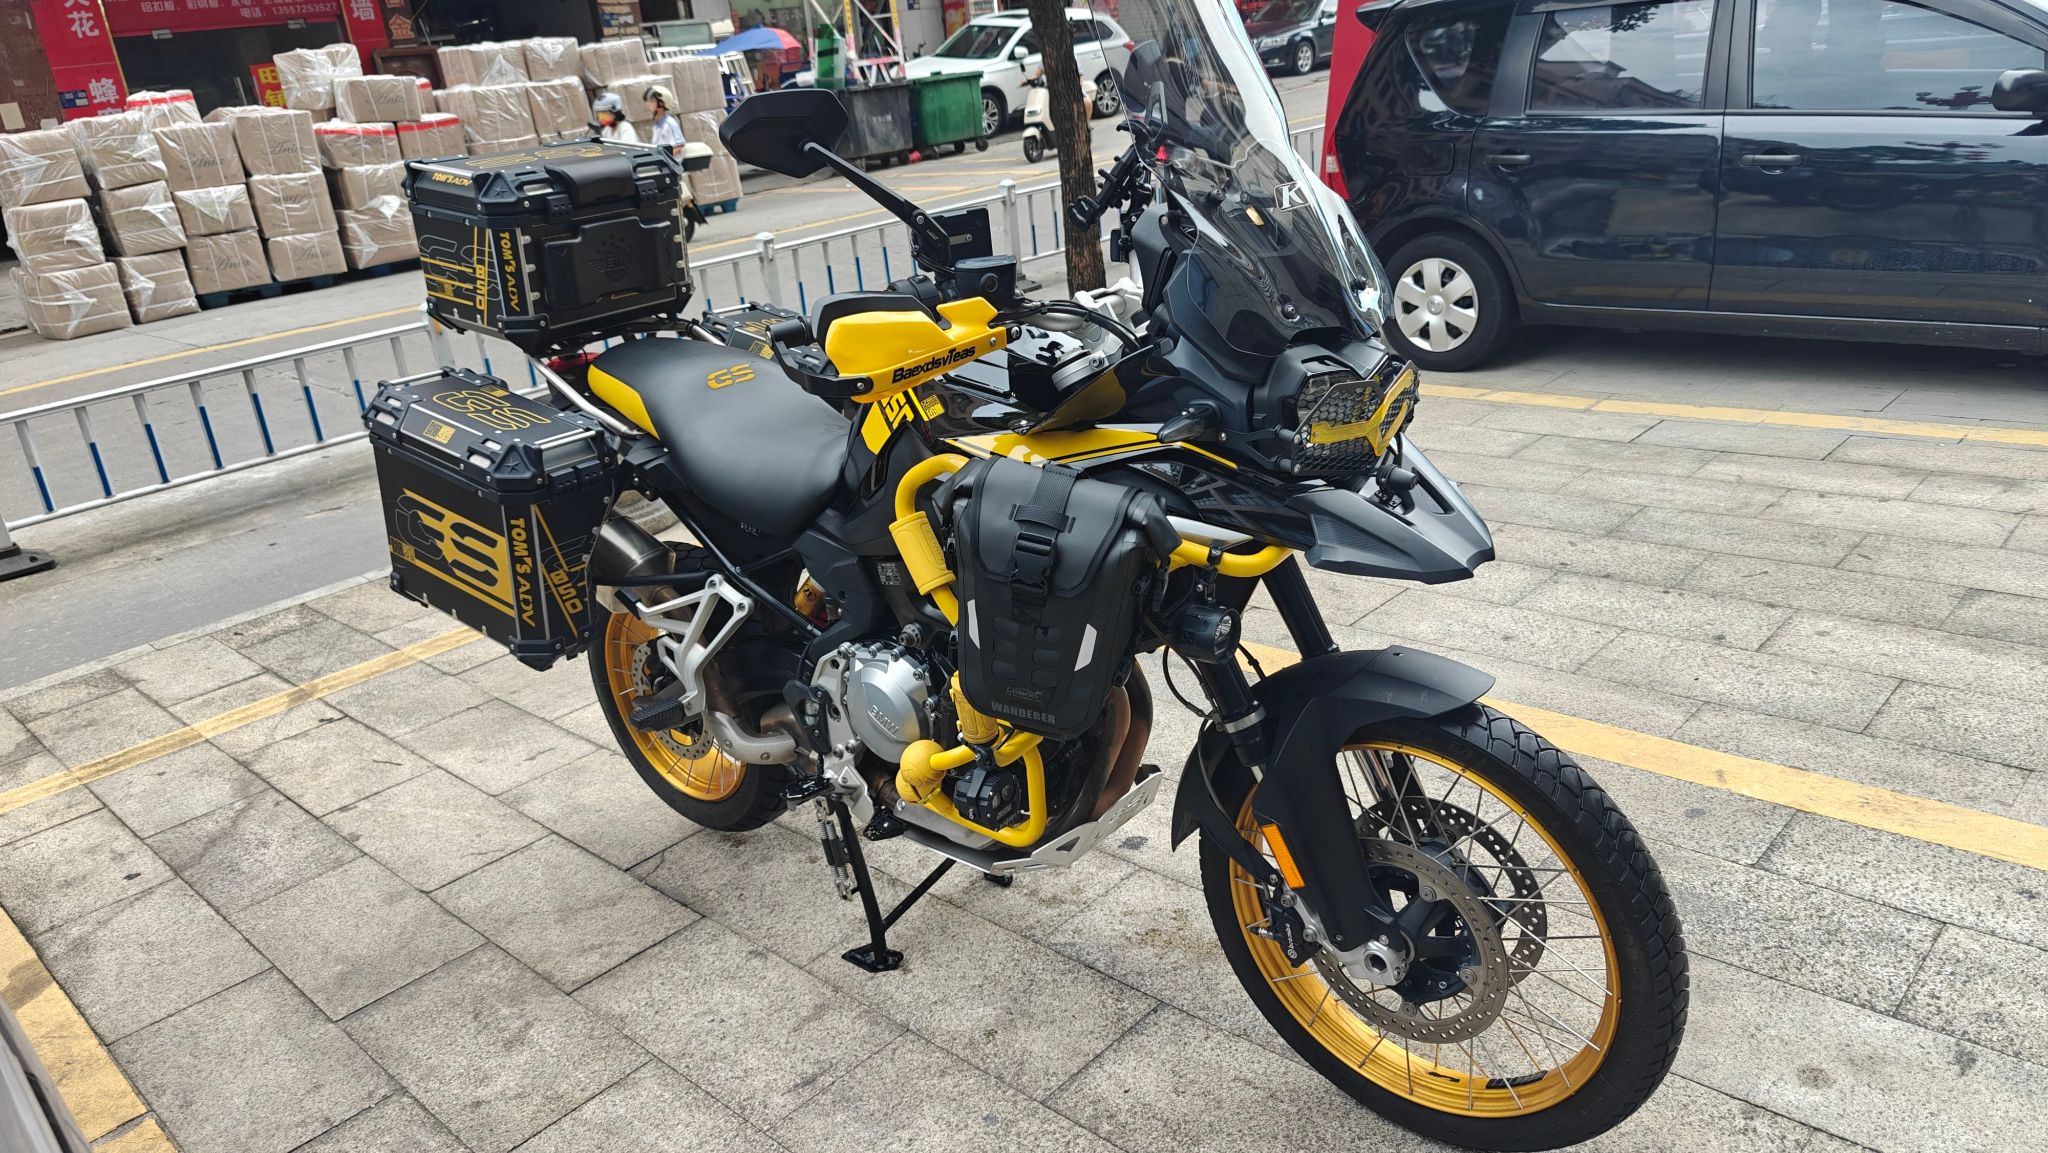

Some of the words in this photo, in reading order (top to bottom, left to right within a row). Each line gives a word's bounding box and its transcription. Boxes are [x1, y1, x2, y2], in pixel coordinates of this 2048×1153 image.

[706, 361, 757, 390] GS
[516, 575, 536, 628] ADV
[869, 704, 900, 736] BMW
[991, 700, 1056, 725] WANDERER
